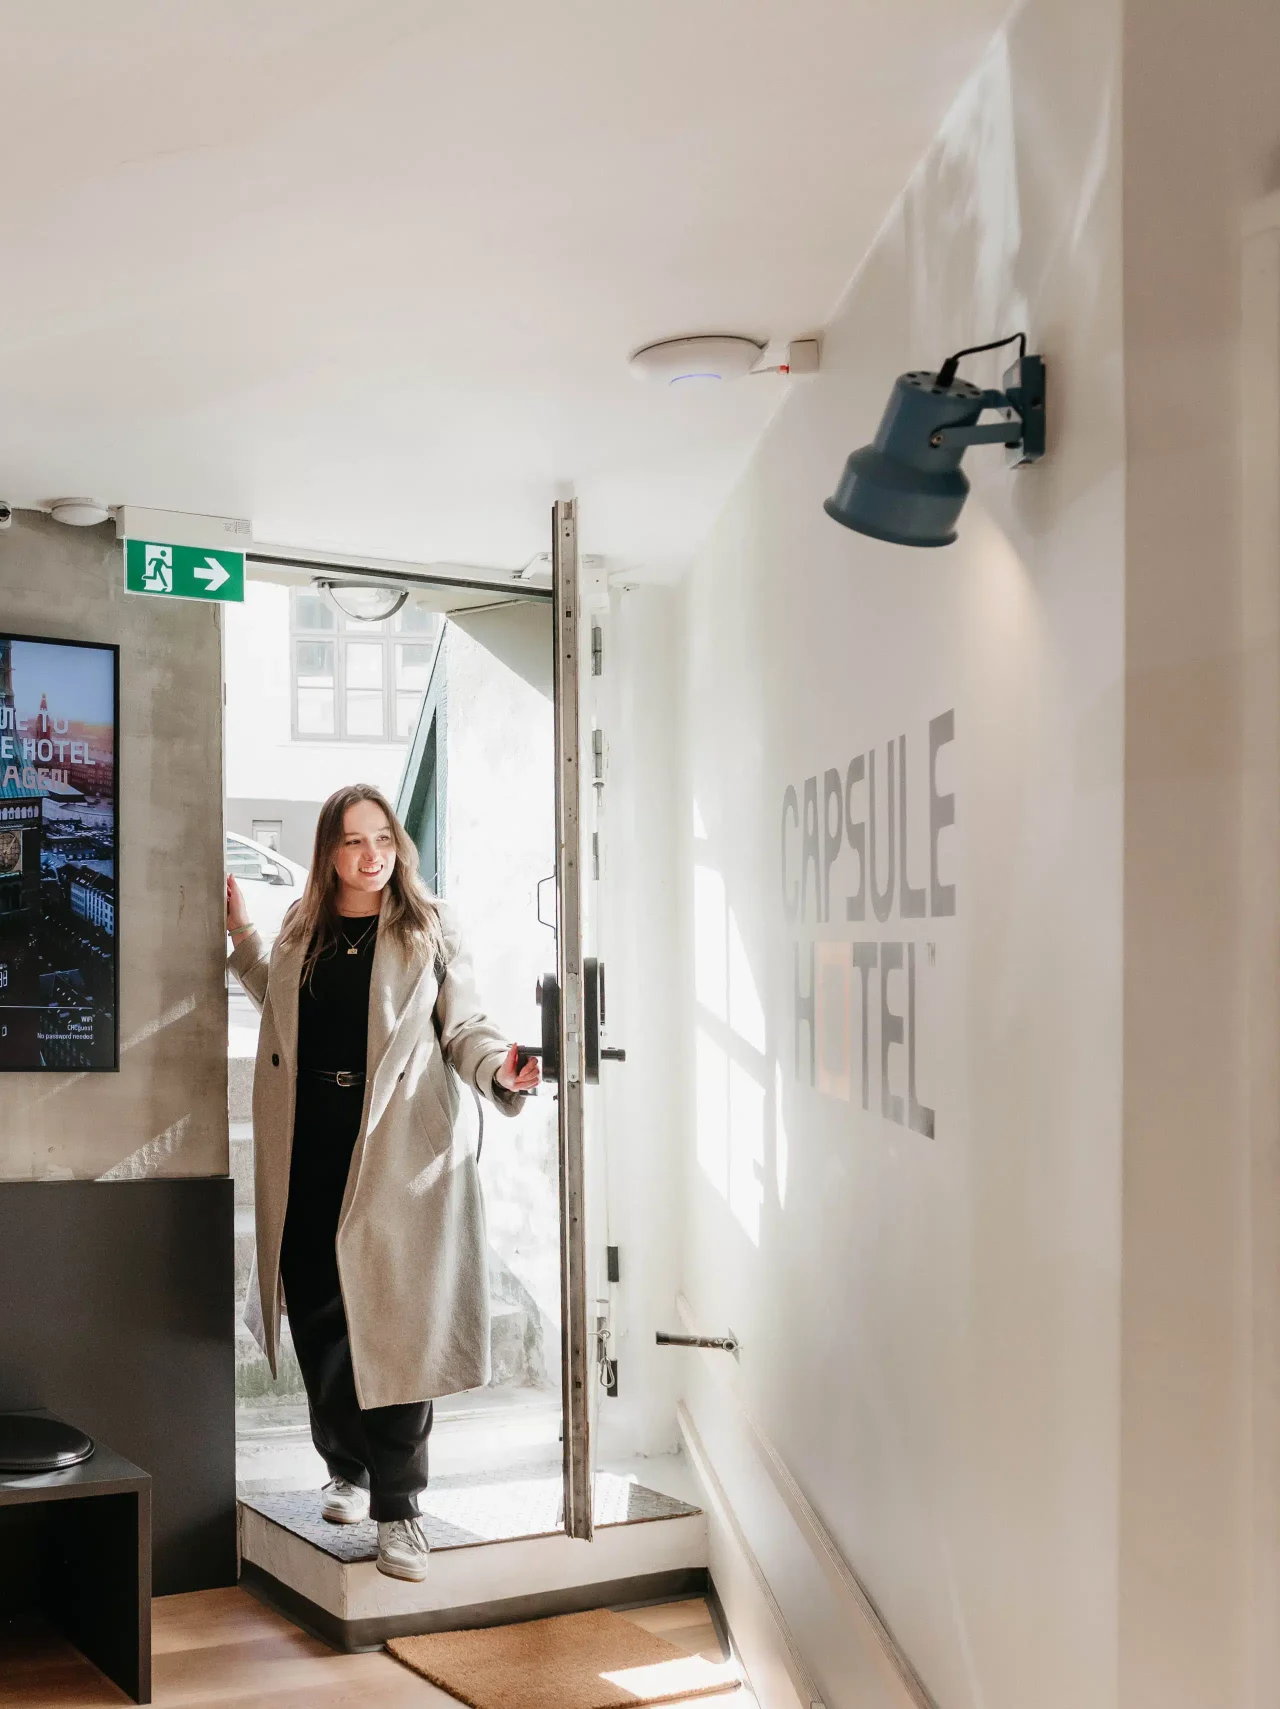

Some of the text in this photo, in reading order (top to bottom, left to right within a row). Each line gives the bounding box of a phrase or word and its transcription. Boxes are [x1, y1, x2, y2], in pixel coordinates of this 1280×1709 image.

[22, 737, 96, 765] HOTEL
[781, 708, 956, 923] CAPSULE
[45, 1032, 72, 1040] password
[794, 941, 936, 1140] HOTEL
